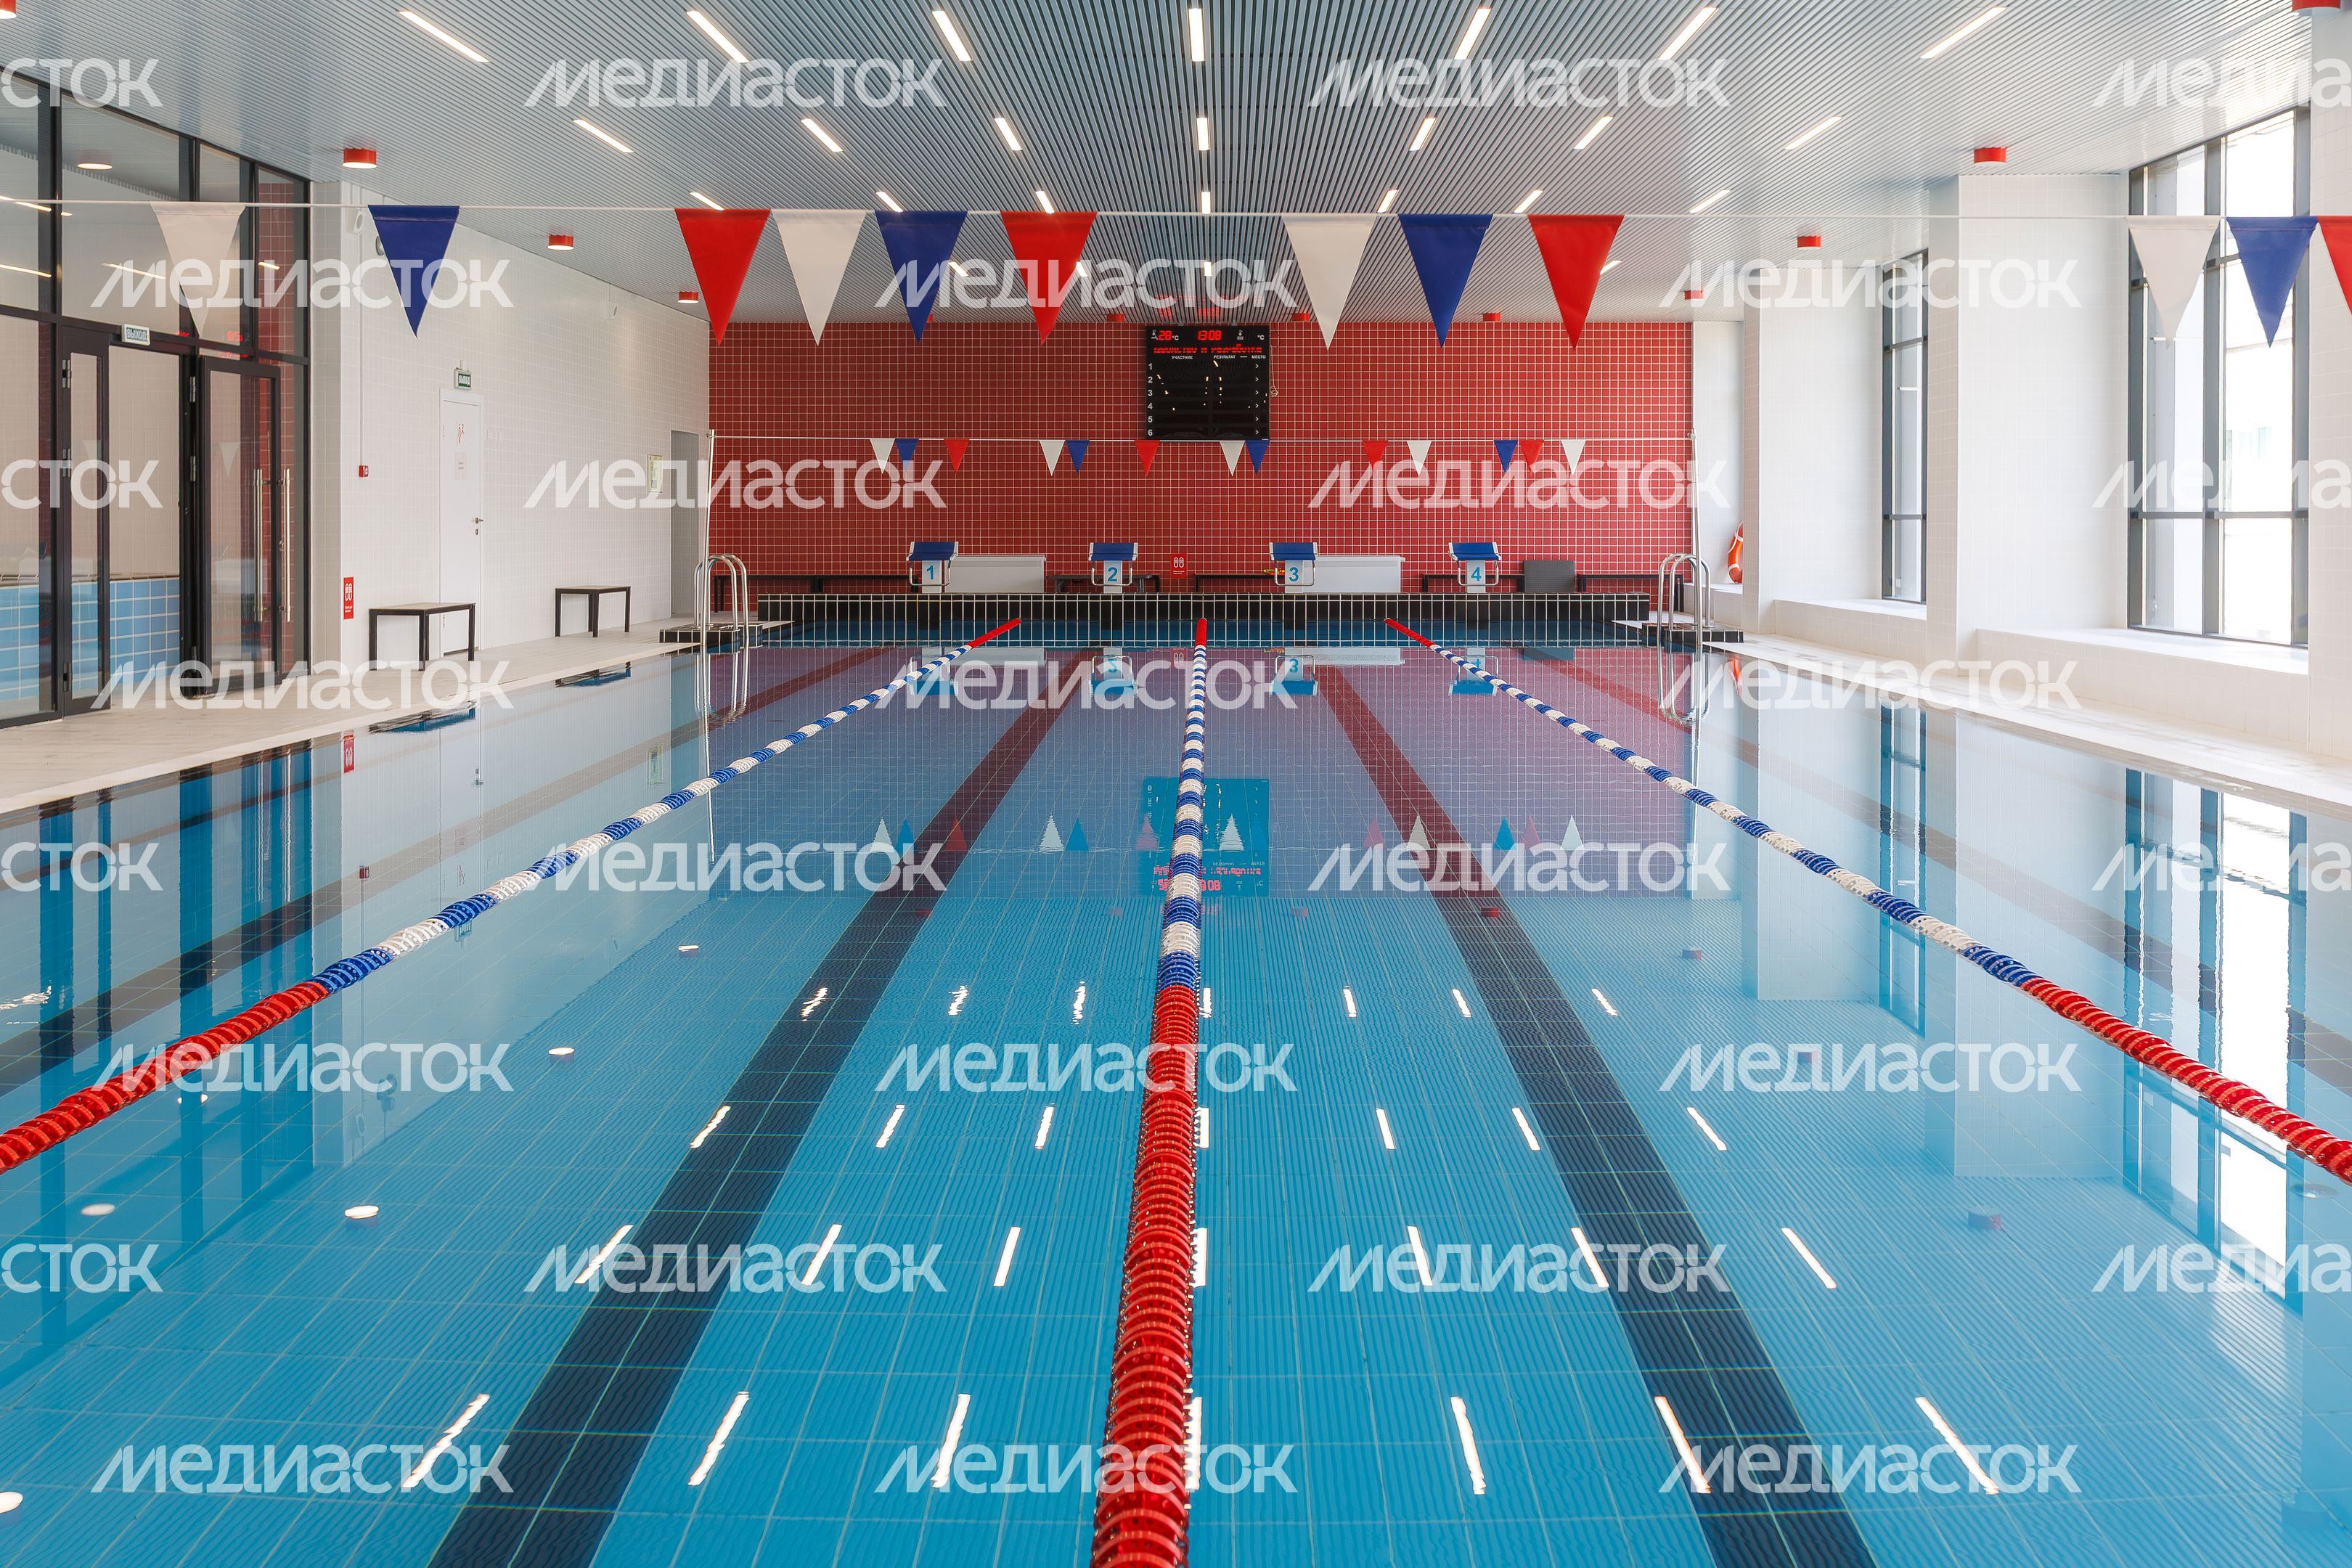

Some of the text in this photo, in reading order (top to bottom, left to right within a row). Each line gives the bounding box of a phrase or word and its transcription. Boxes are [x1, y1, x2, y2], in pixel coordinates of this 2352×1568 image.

[1158, 330, 1172, 340] 28
[926, 565, 934, 580] 1
[1108, 566, 1118, 582] 2
[1289, 566, 1299, 582] 3
[1471, 566, 1482, 581] 4
